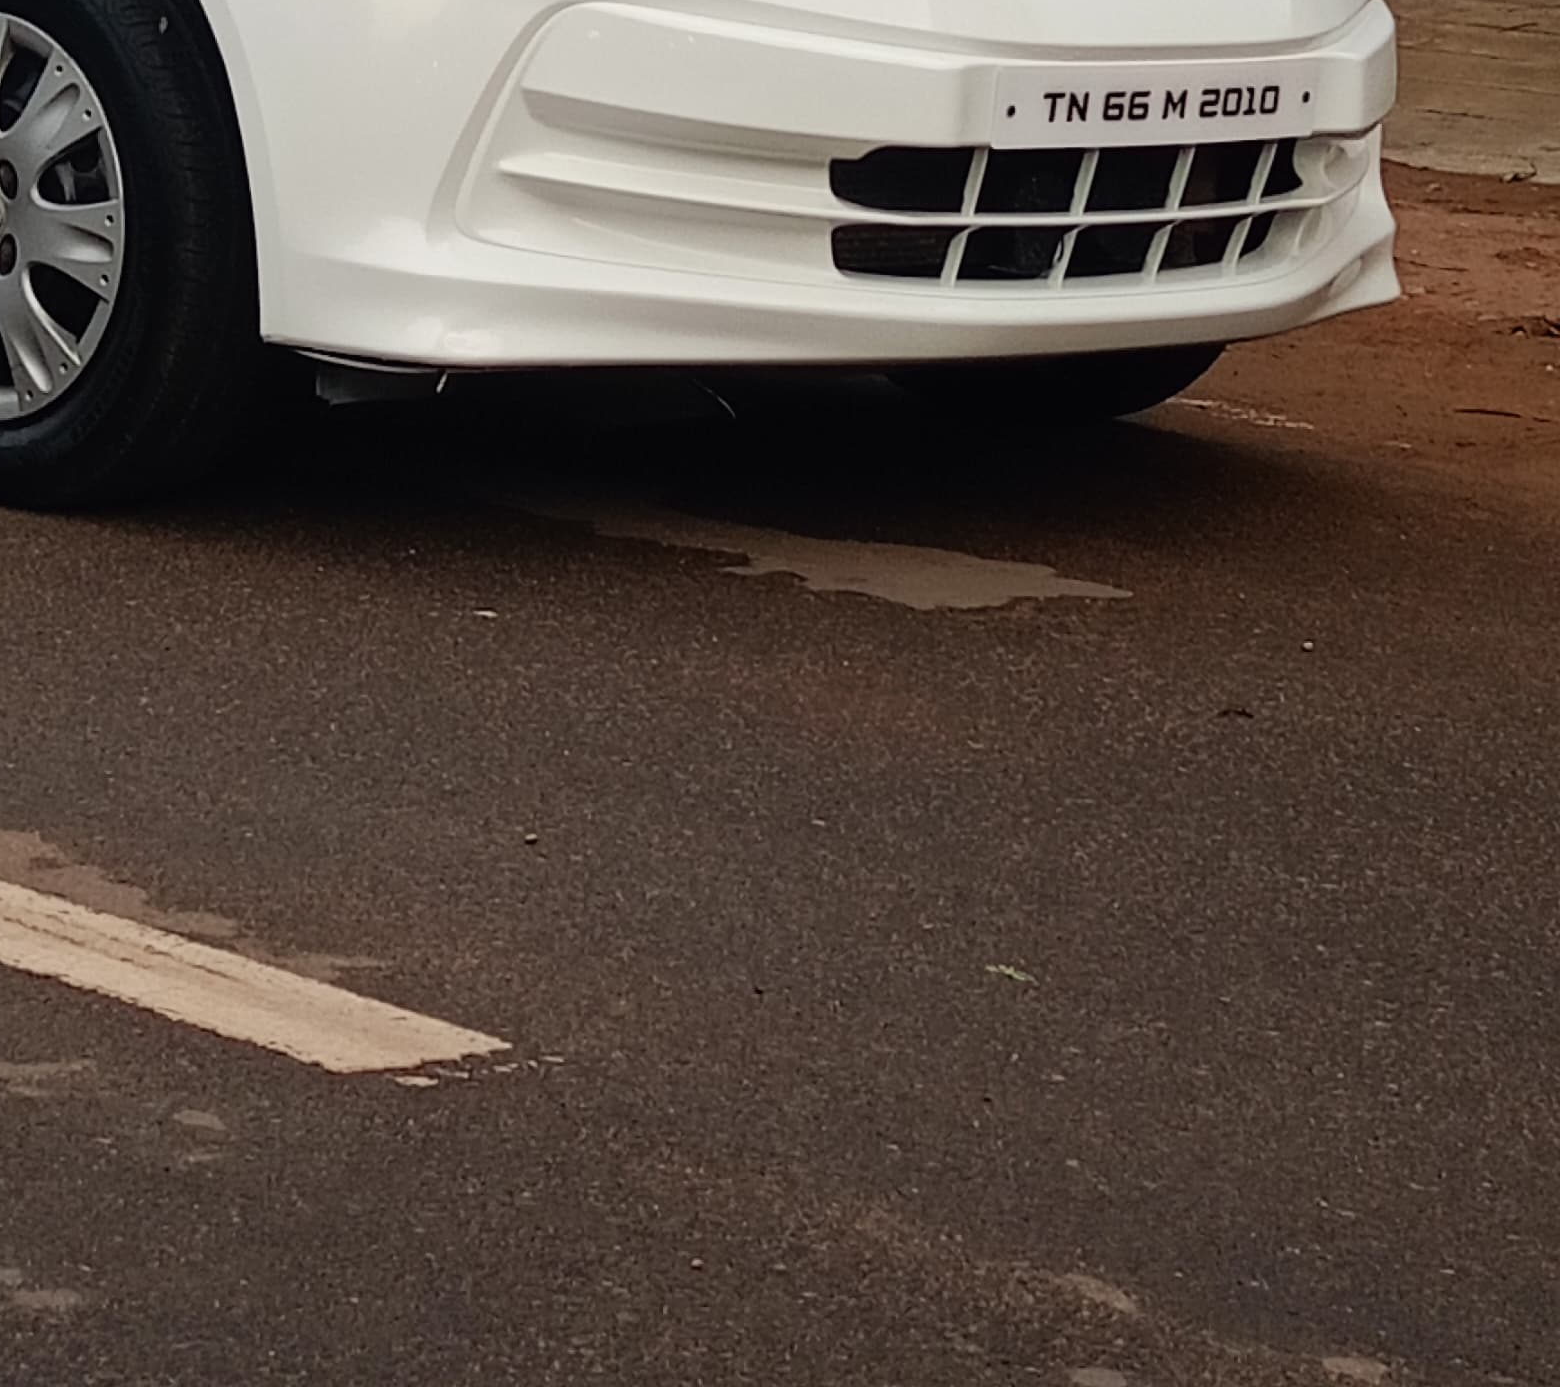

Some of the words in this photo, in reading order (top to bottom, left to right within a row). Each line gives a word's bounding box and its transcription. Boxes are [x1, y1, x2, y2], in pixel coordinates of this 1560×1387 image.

[1043, 90, 1090, 123] TN
[1102, 90, 1151, 121] 66
[1161, 89, 1188, 120] M
[1199, 85, 1280, 118] 2010
